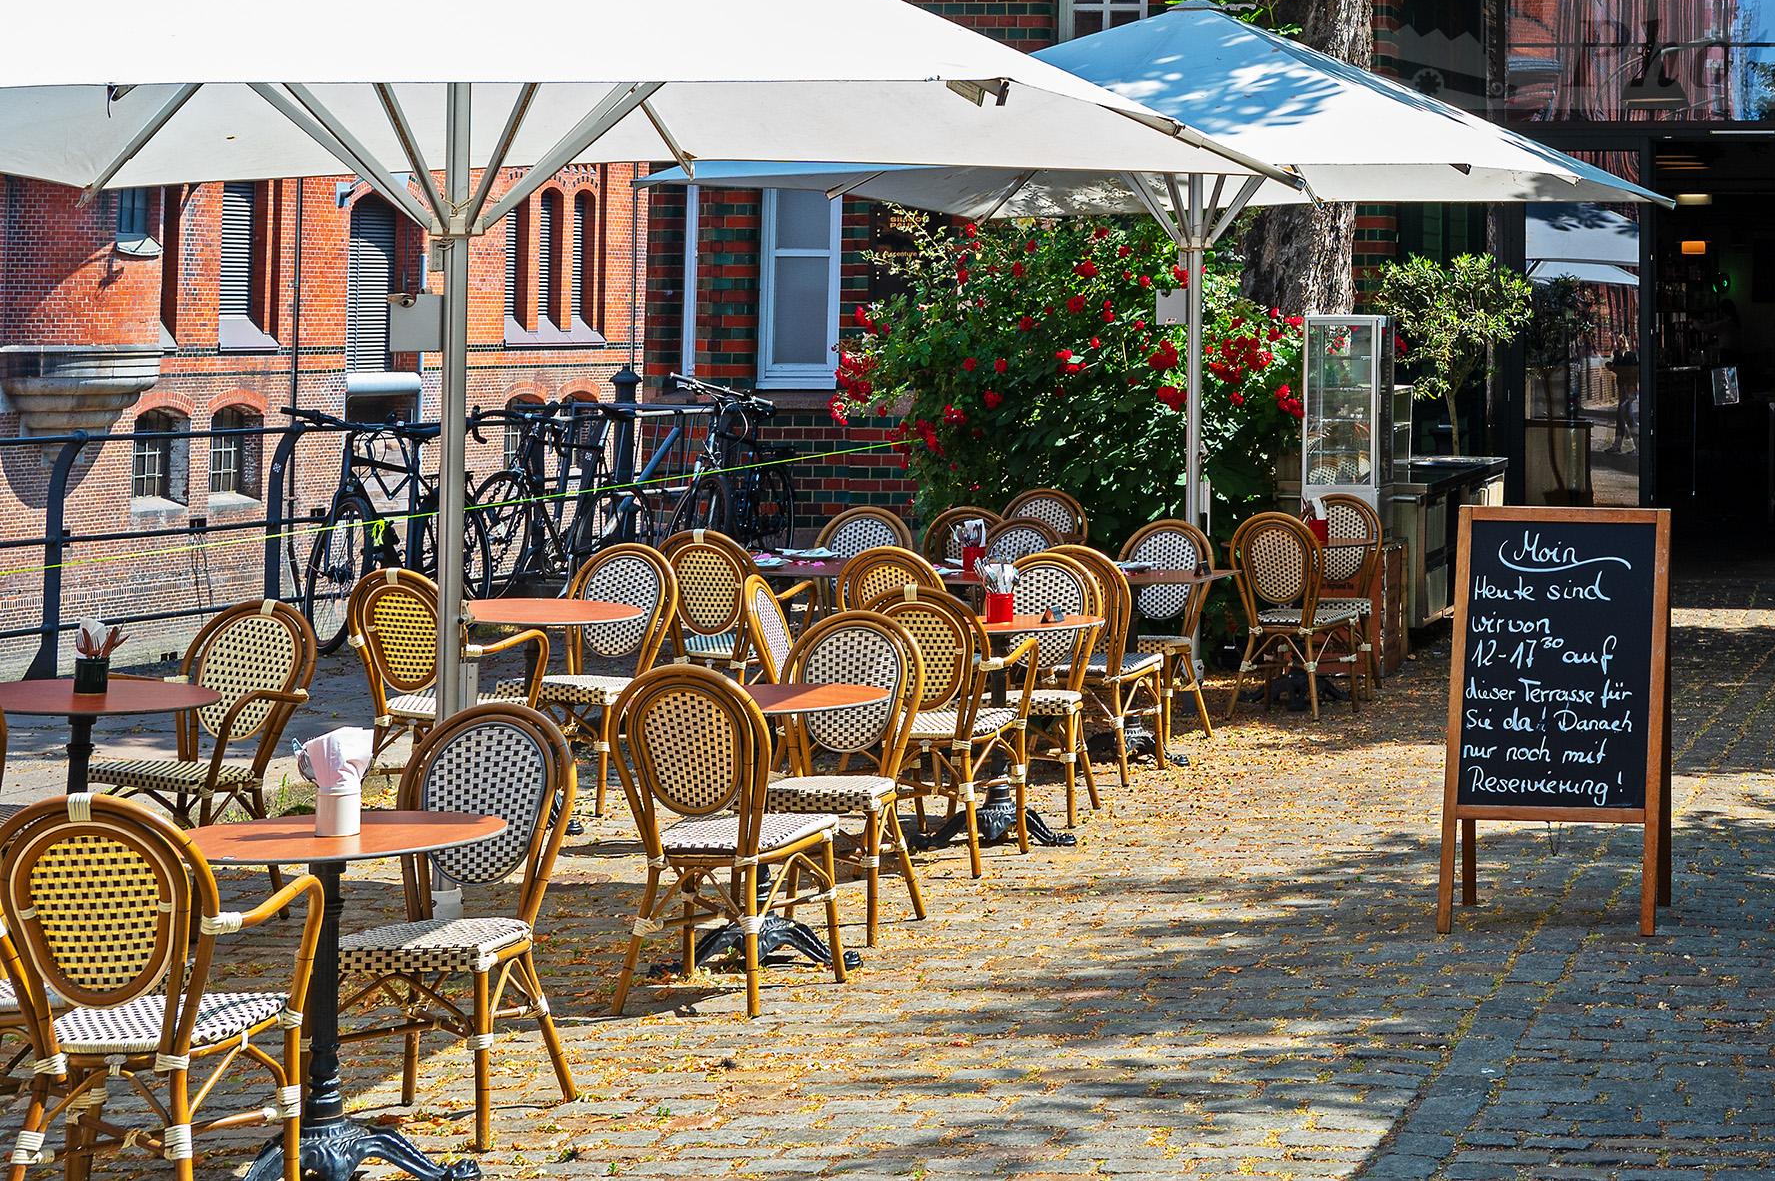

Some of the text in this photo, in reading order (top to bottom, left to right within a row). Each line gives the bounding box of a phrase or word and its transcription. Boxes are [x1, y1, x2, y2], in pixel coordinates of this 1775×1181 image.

[1474, 571, 1611, 601] Heute sind
[1472, 611, 1550, 634] wir von
[1562, 635, 1617, 675] auf
[1465, 676, 1633, 708] dieser Terrasse für
[1466, 709, 1494, 730] Sie
[1553, 709, 1633, 732] Danach
[1463, 736, 1607, 764] nur noch mit
